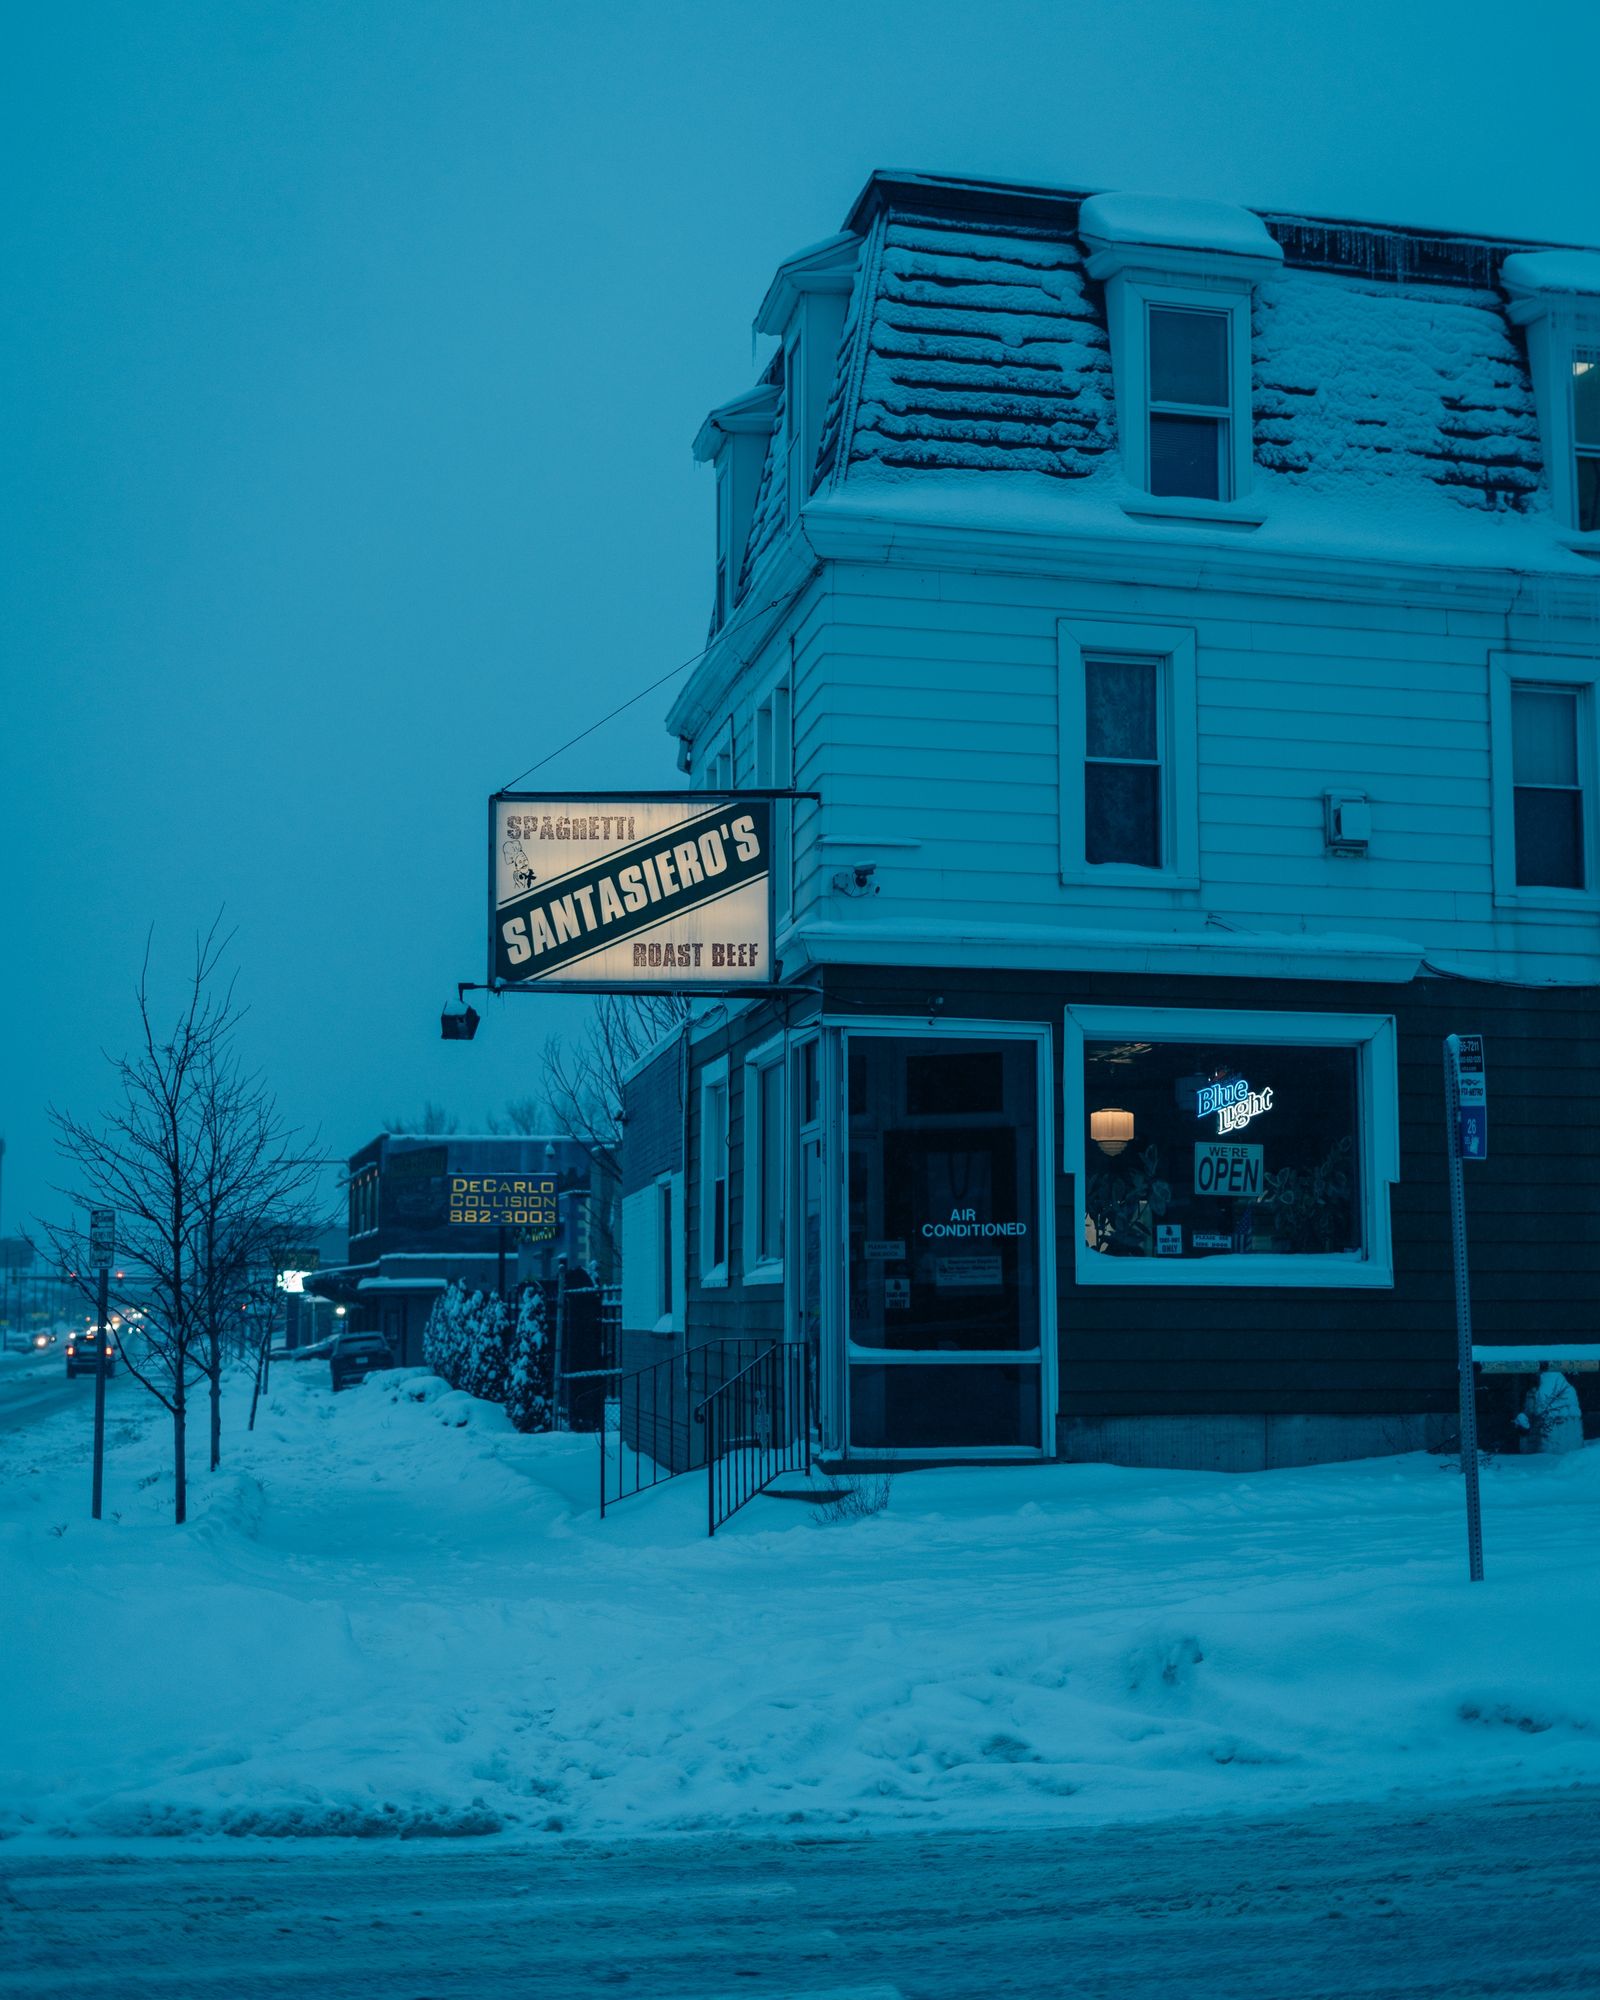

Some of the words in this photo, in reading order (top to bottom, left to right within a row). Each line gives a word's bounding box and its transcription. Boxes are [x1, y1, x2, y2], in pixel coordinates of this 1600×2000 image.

[506, 815, 635, 841] SPAGHETTI
[501, 815, 761, 965] SANTASIERO'S
[633, 943, 703, 967] ROAST
[712, 942, 758, 967] BEEF
[1196, 1079, 1249, 1118] Blue
[1217, 1086, 1274, 1135] Light
[1467, 1118, 1477, 1134] 26
[1209, 1146, 1249, 1158] WE'RE
[1199, 1157, 1260, 1193] OPEN
[450, 1210, 556, 1223] 882-3003
[950, 1208, 976, 1222] AIR
[922, 1223, 1027, 1237] CONDITIONED
[1162, 1244, 1178, 1253] ONLY
